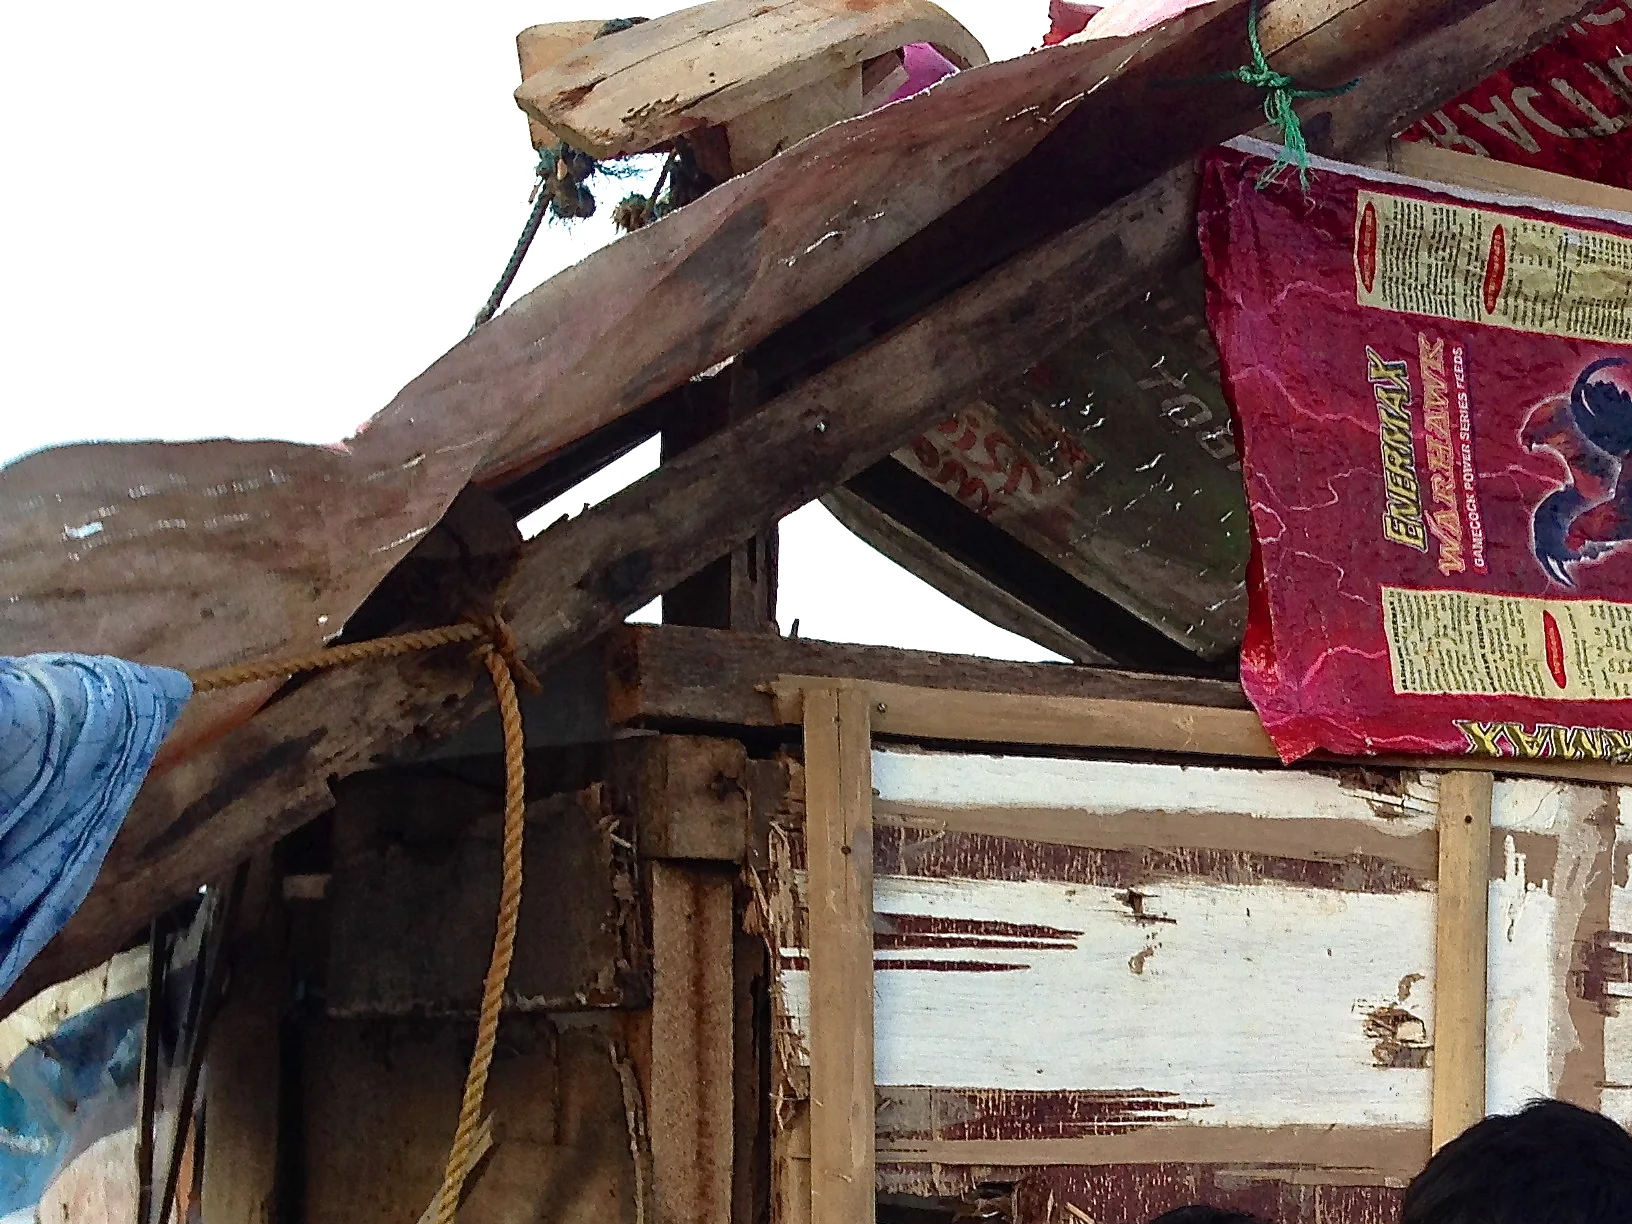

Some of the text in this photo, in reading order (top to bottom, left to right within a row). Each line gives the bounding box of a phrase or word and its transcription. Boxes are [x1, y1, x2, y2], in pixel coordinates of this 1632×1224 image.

[1365, 345, 1427, 551] ENERMAX
[1417, 332, 1464, 575] WARHAWK
[1452, 346, 1484, 566] GAMECOCK POWER SERIES FEEDS
